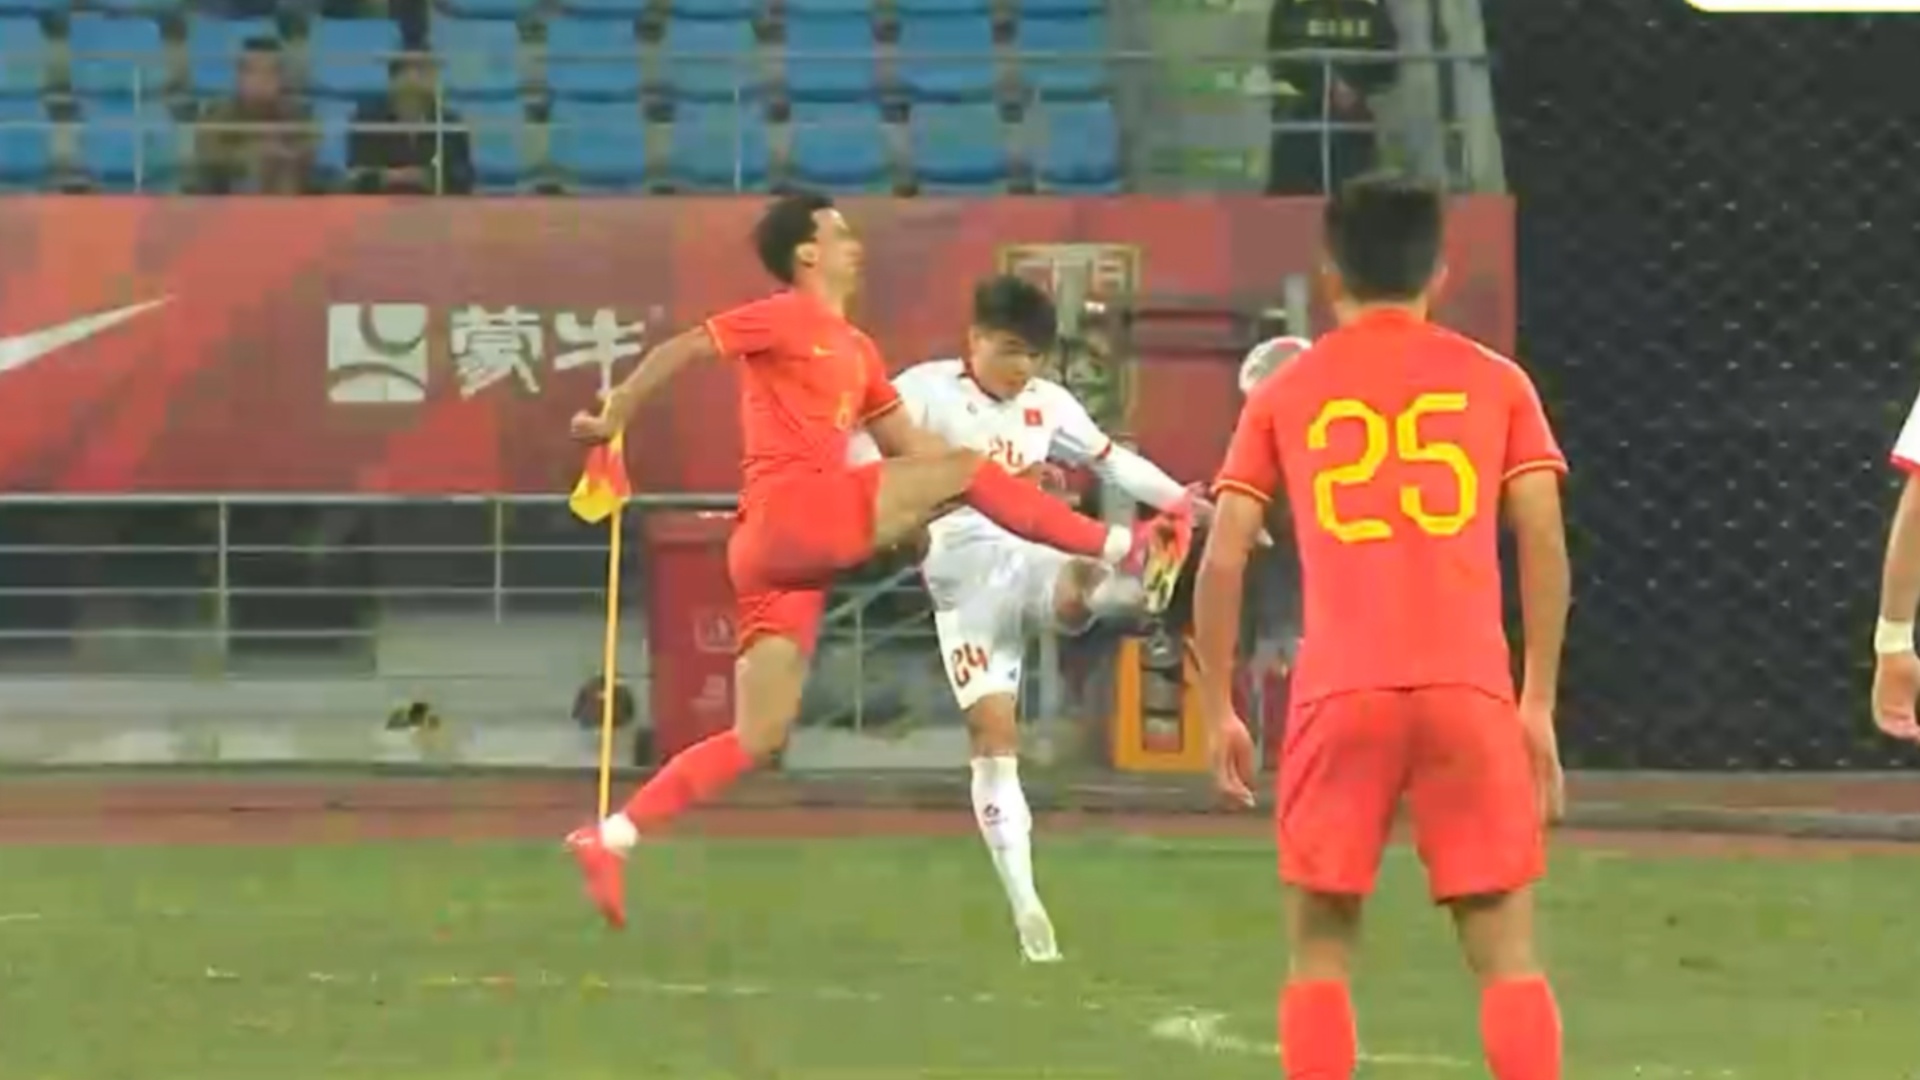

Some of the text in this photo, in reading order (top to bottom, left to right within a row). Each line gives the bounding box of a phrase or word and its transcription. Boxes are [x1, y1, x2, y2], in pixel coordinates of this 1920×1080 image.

[451, 304, 645, 399] 蒙牛
[1307, 392, 1478, 541] 25
[951, 642, 988, 688] 24
